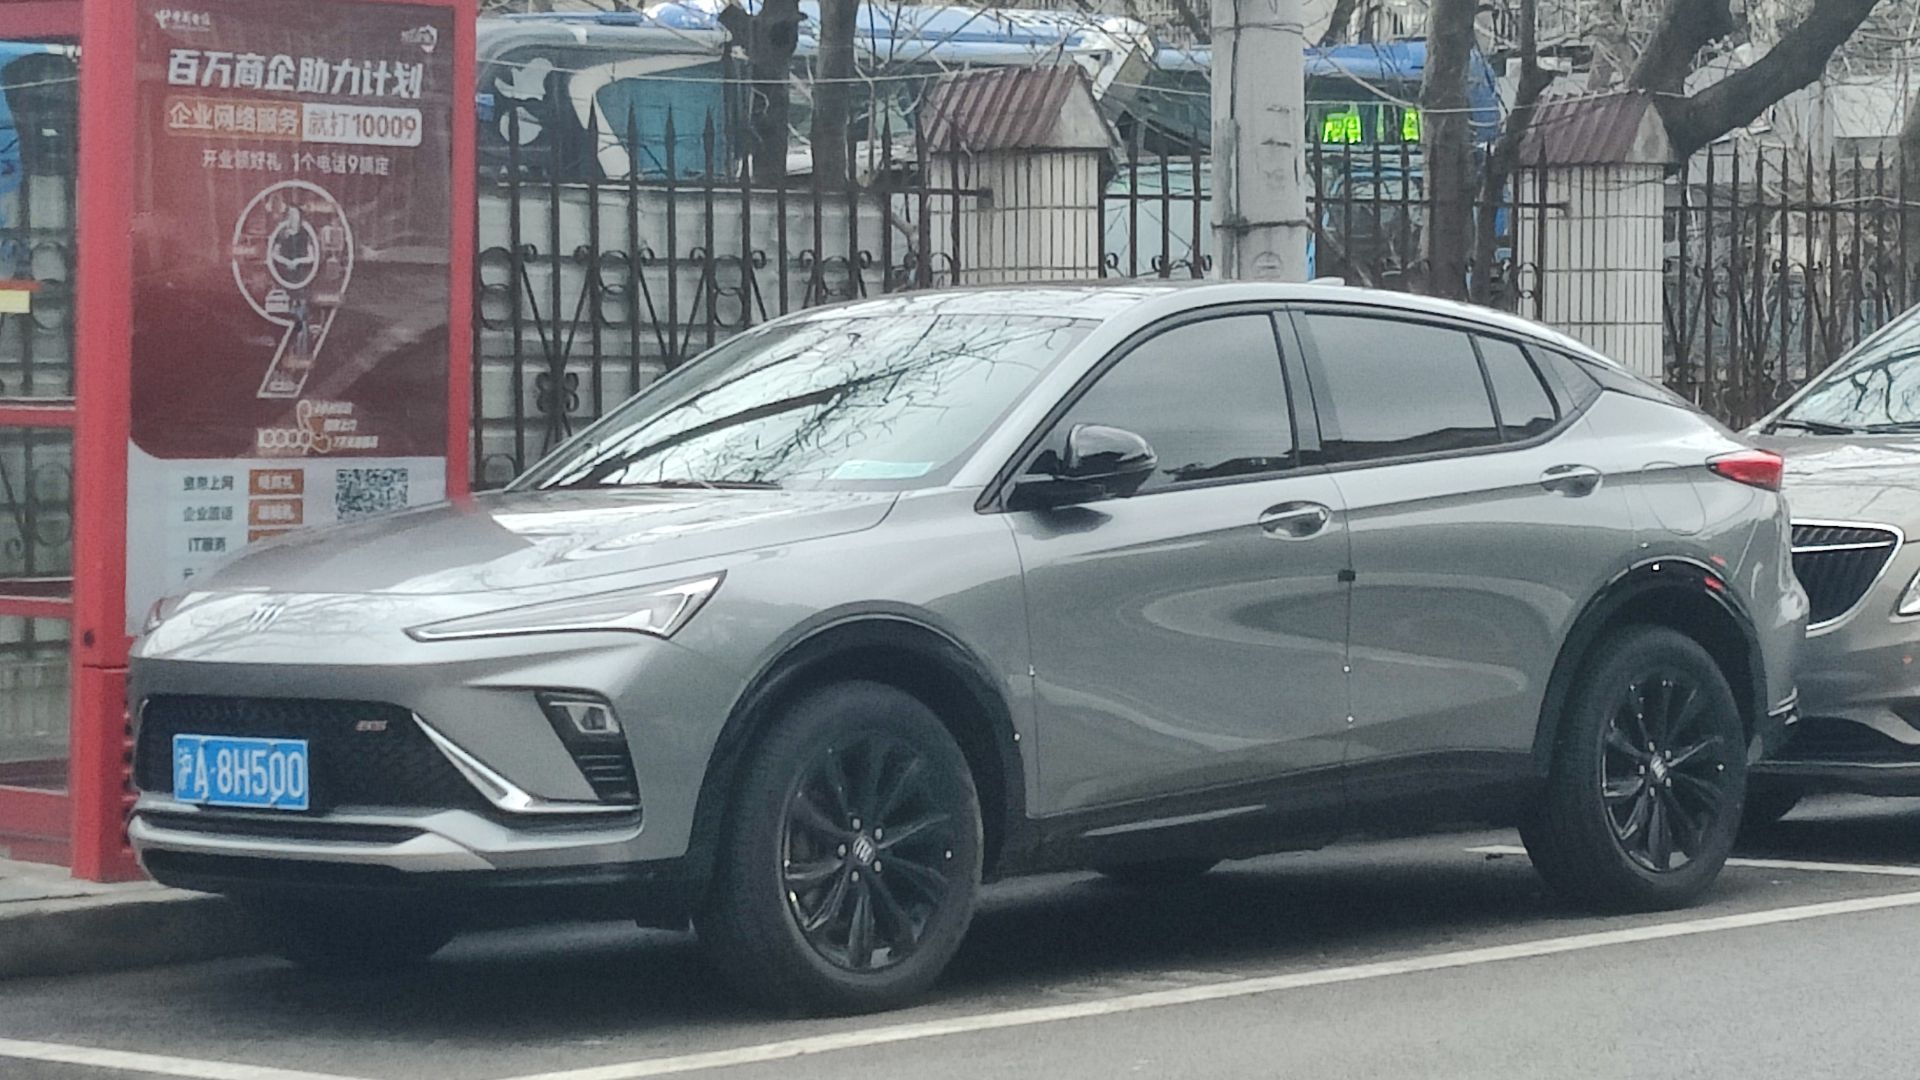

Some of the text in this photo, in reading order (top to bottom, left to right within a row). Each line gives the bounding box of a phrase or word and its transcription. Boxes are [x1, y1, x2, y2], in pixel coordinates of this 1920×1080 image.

[167, 48, 424, 99] 百万商企助力计划
[168, 101, 418, 142] 企业网络服务 就打10009
